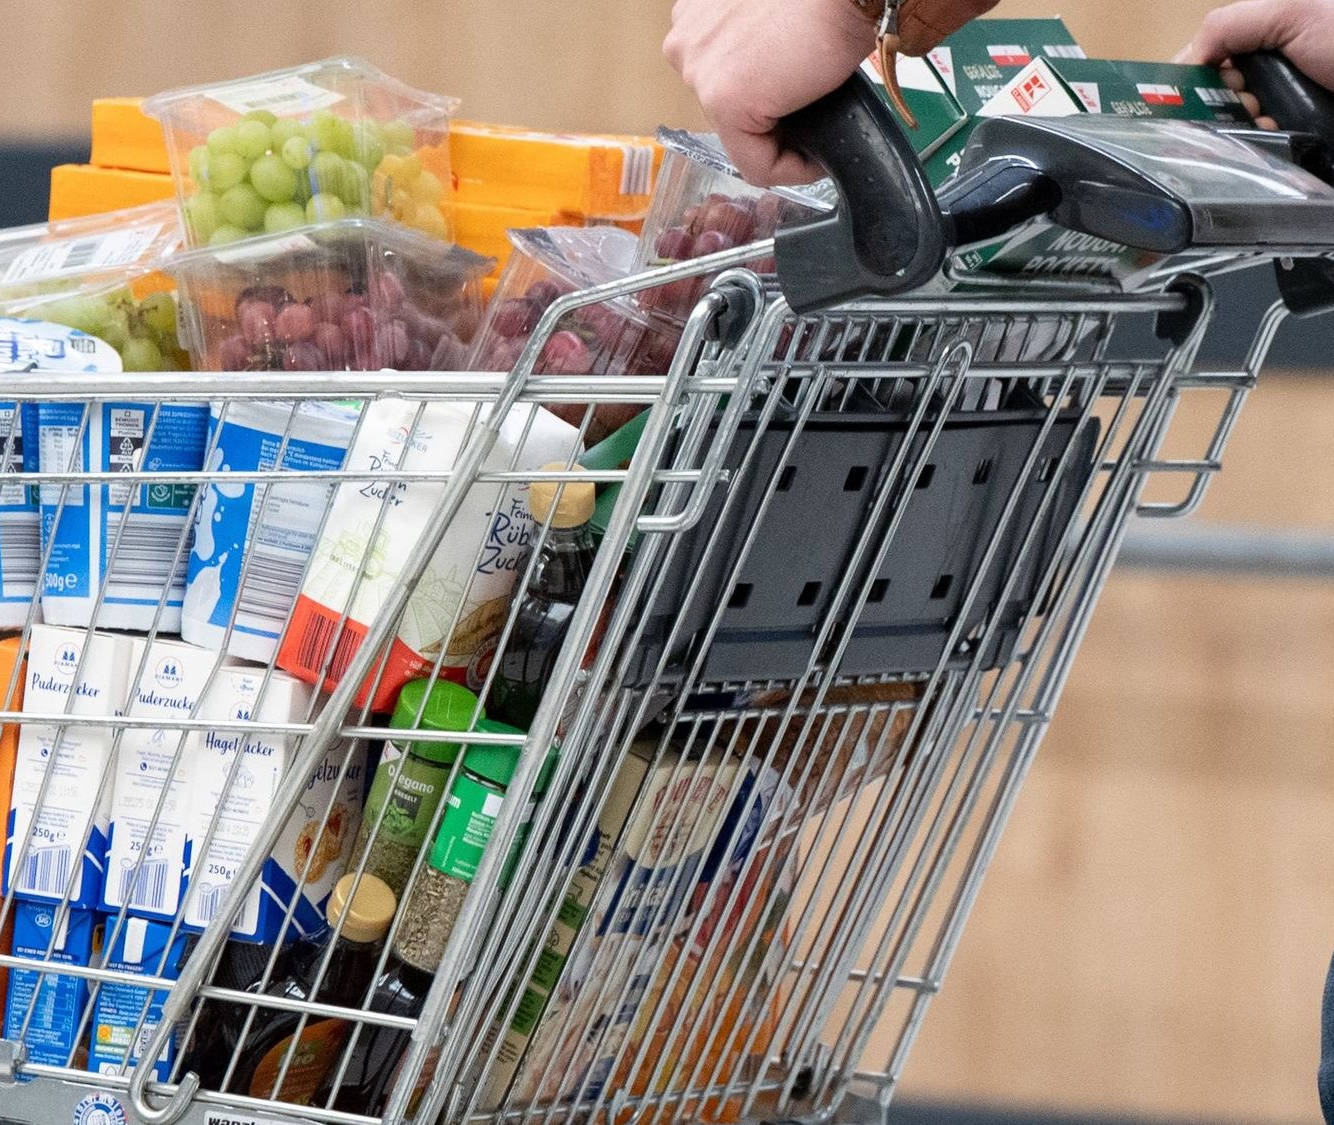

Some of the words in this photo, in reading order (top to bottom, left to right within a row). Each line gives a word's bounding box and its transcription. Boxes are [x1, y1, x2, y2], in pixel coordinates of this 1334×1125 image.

[31, 672, 101, 698] Puderzcker
[133, 687, 196, 711] Puderzucke
[205, 731, 275, 757] Hagelucker
[387, 764, 435, 794] Oegano
